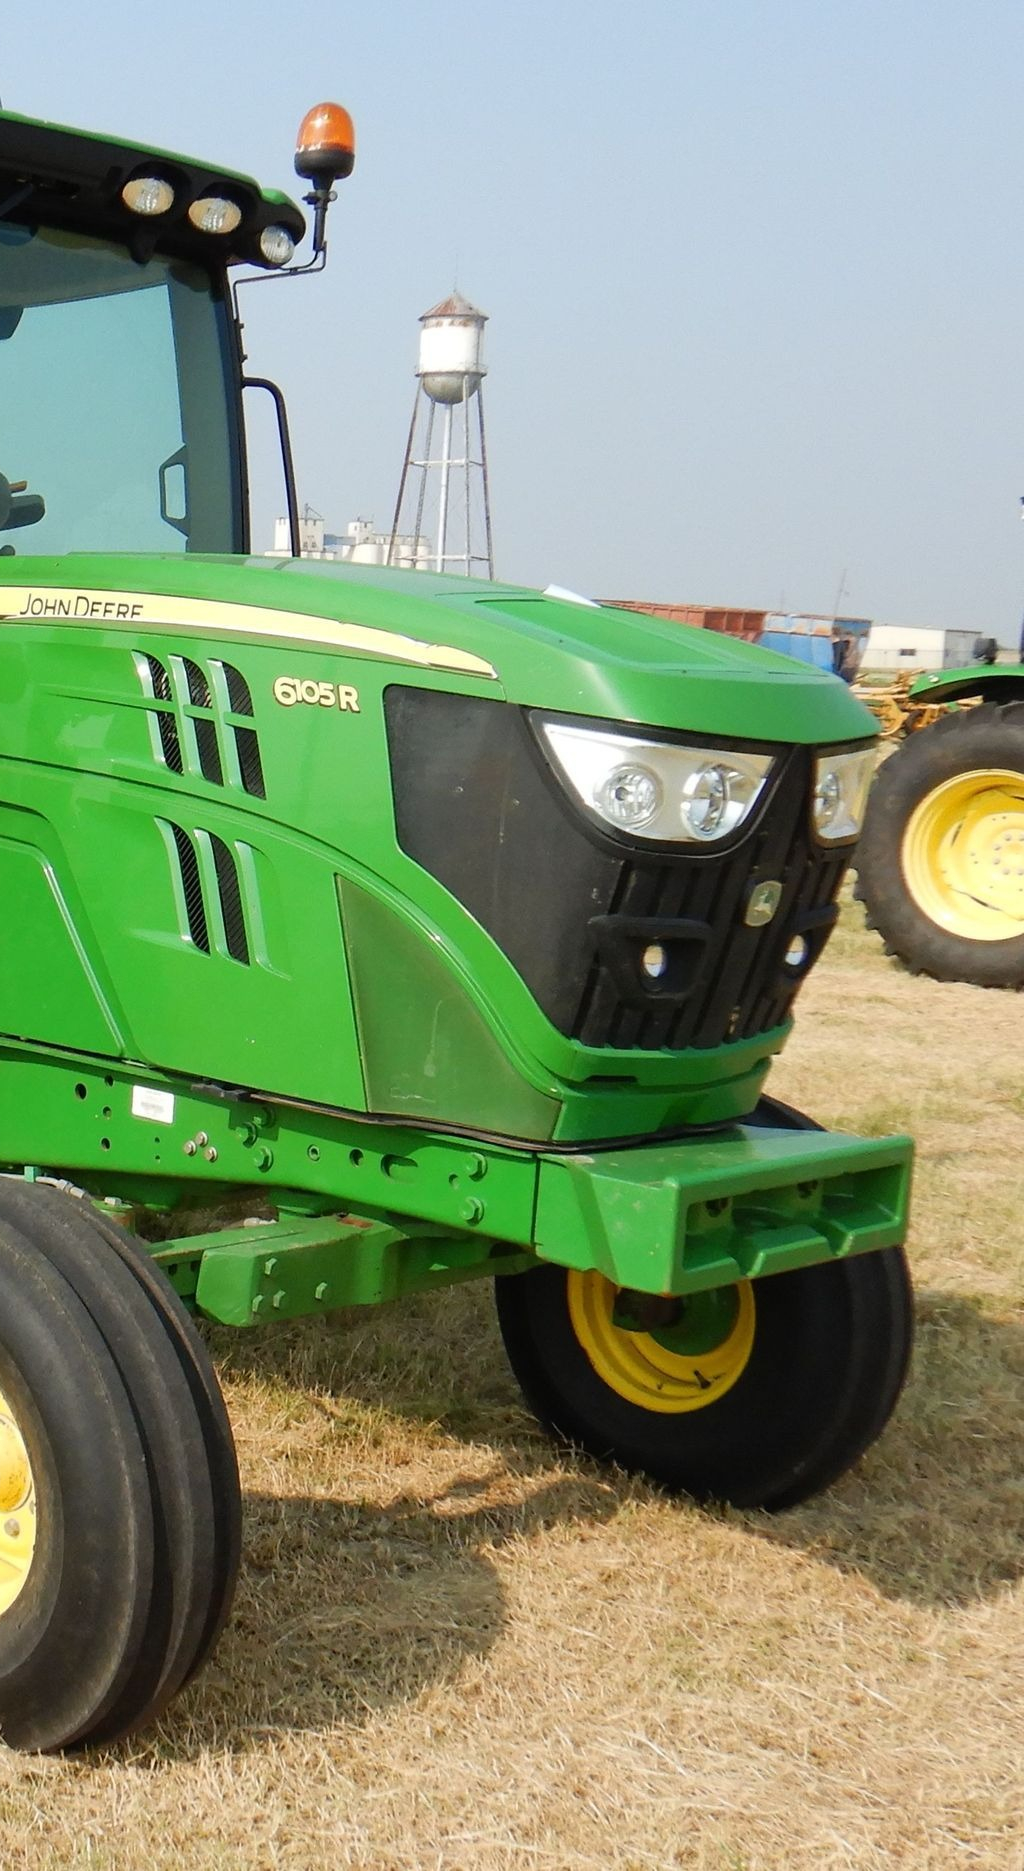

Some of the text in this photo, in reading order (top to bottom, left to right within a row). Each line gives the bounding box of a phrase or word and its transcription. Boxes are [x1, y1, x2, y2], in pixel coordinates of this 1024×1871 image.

[19, 593, 144, 619] JOHN DEERE
[273, 675, 361, 714] 6105R
